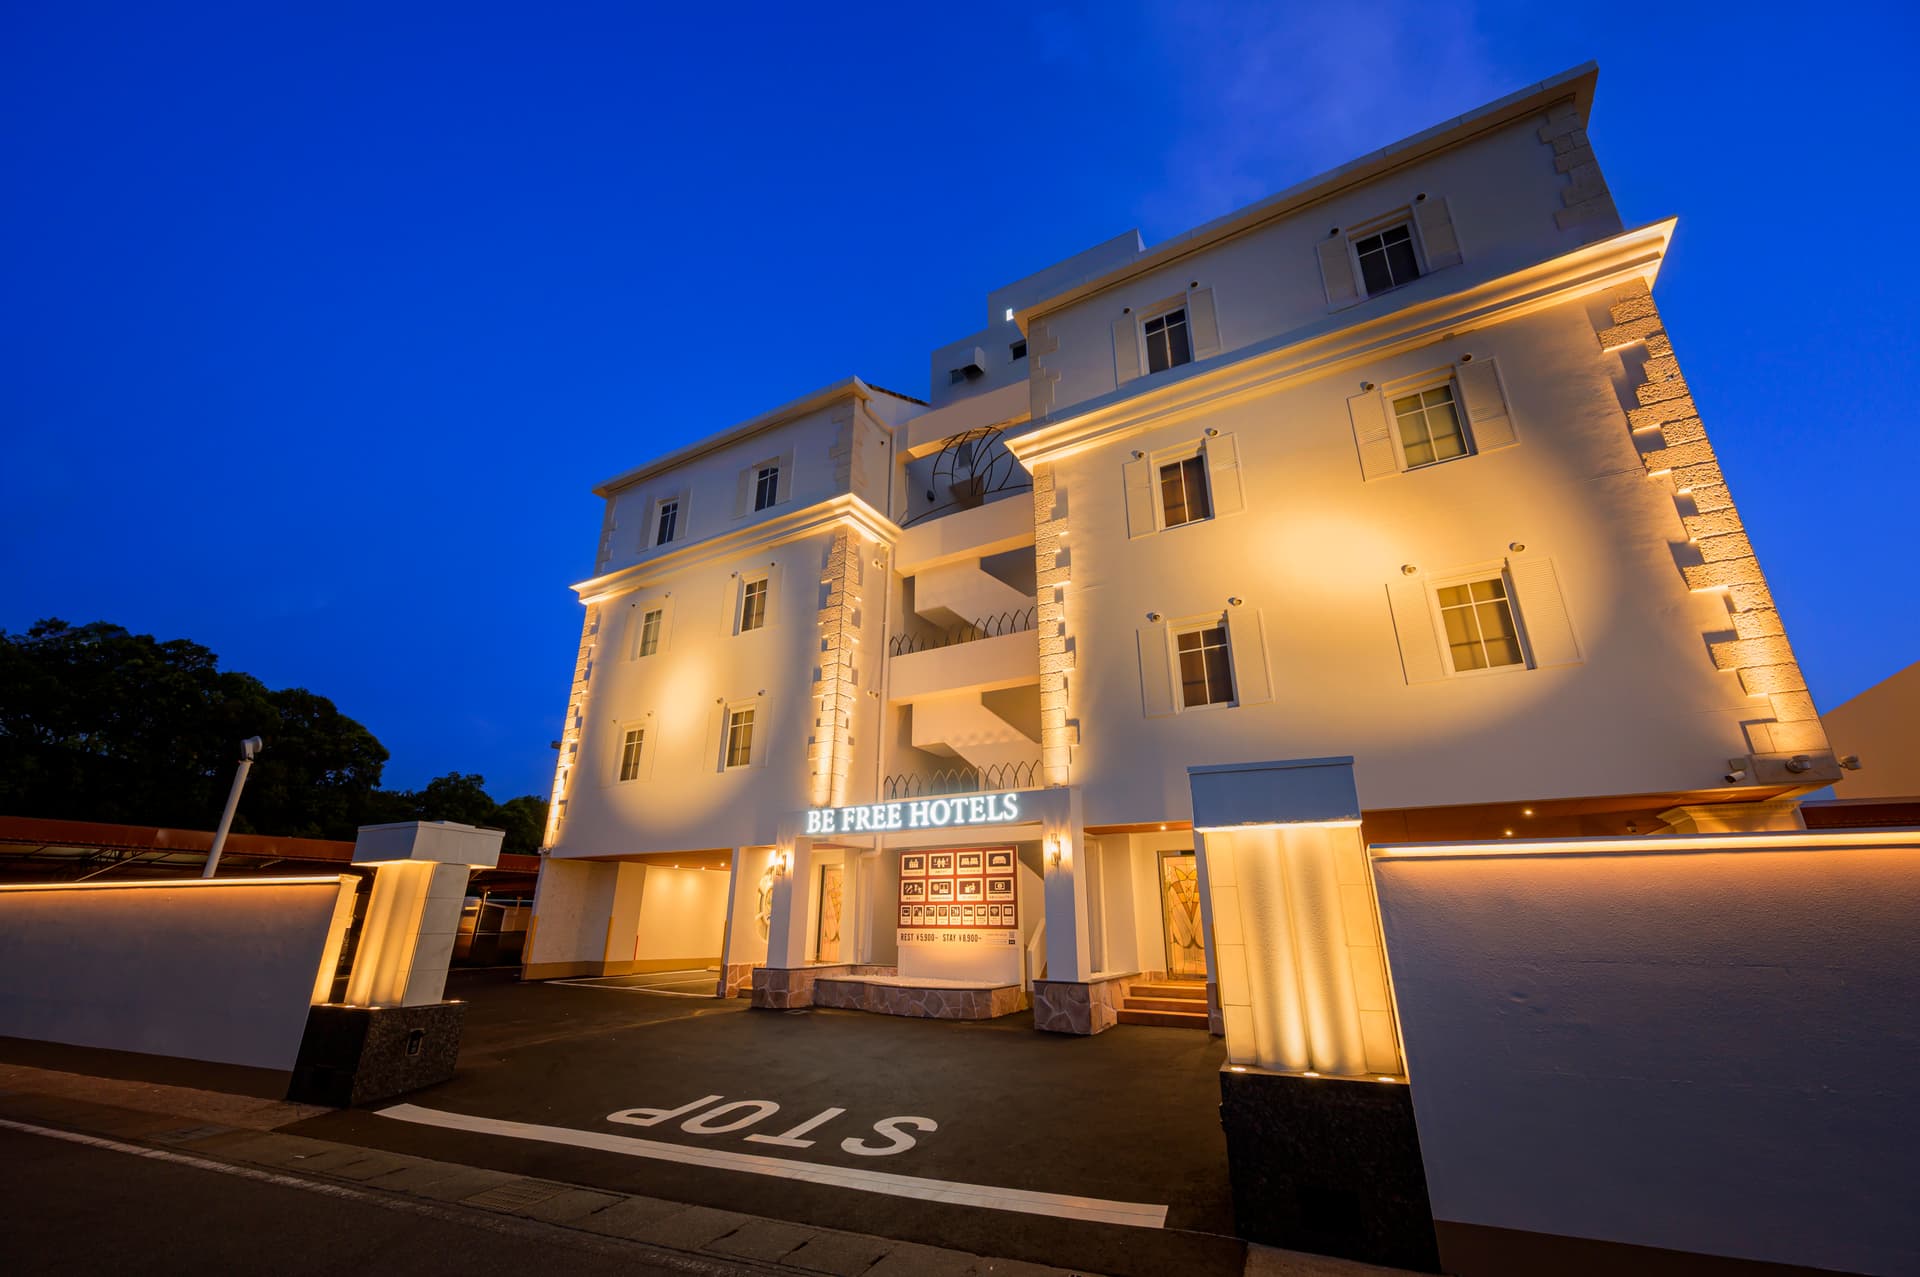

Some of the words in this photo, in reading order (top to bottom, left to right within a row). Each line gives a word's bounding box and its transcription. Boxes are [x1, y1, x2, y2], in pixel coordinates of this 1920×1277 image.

[806, 808, 836, 833] BE
[840, 803, 903, 832] FREE
[908, 793, 1019, 827] HOTELS
[900, 933, 914, 942] REST
[942, 933, 956, 942] STAY
[606, 1094, 939, 1156] STOP
